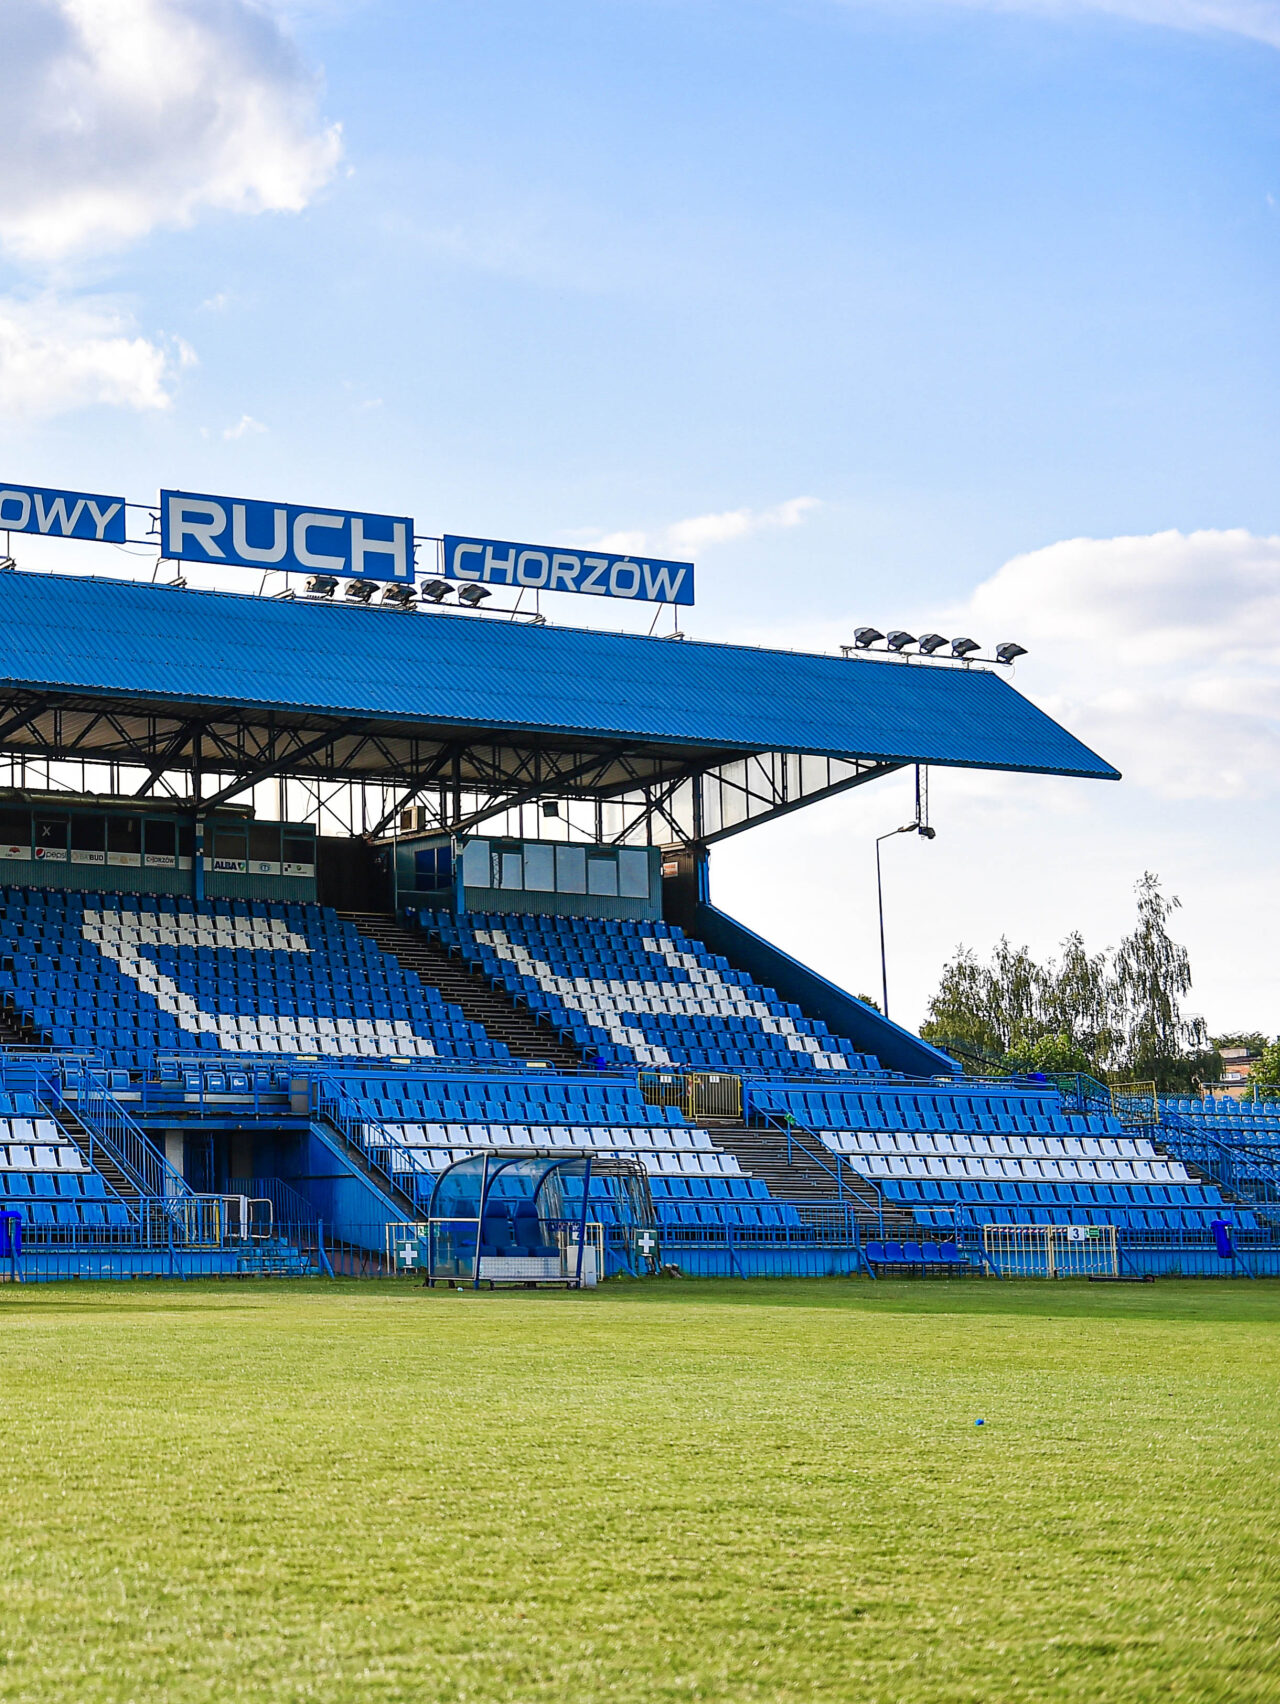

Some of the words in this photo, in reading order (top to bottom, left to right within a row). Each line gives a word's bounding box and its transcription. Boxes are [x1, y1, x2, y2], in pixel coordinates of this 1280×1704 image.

[168, 496, 407, 577] RUCH
[453, 543, 687, 603] CHORZÓW
[146, 856, 174, 864] CHORZÓW
[214, 861, 237, 870] ALBA
[1072, 1228, 1080, 1239] 3
